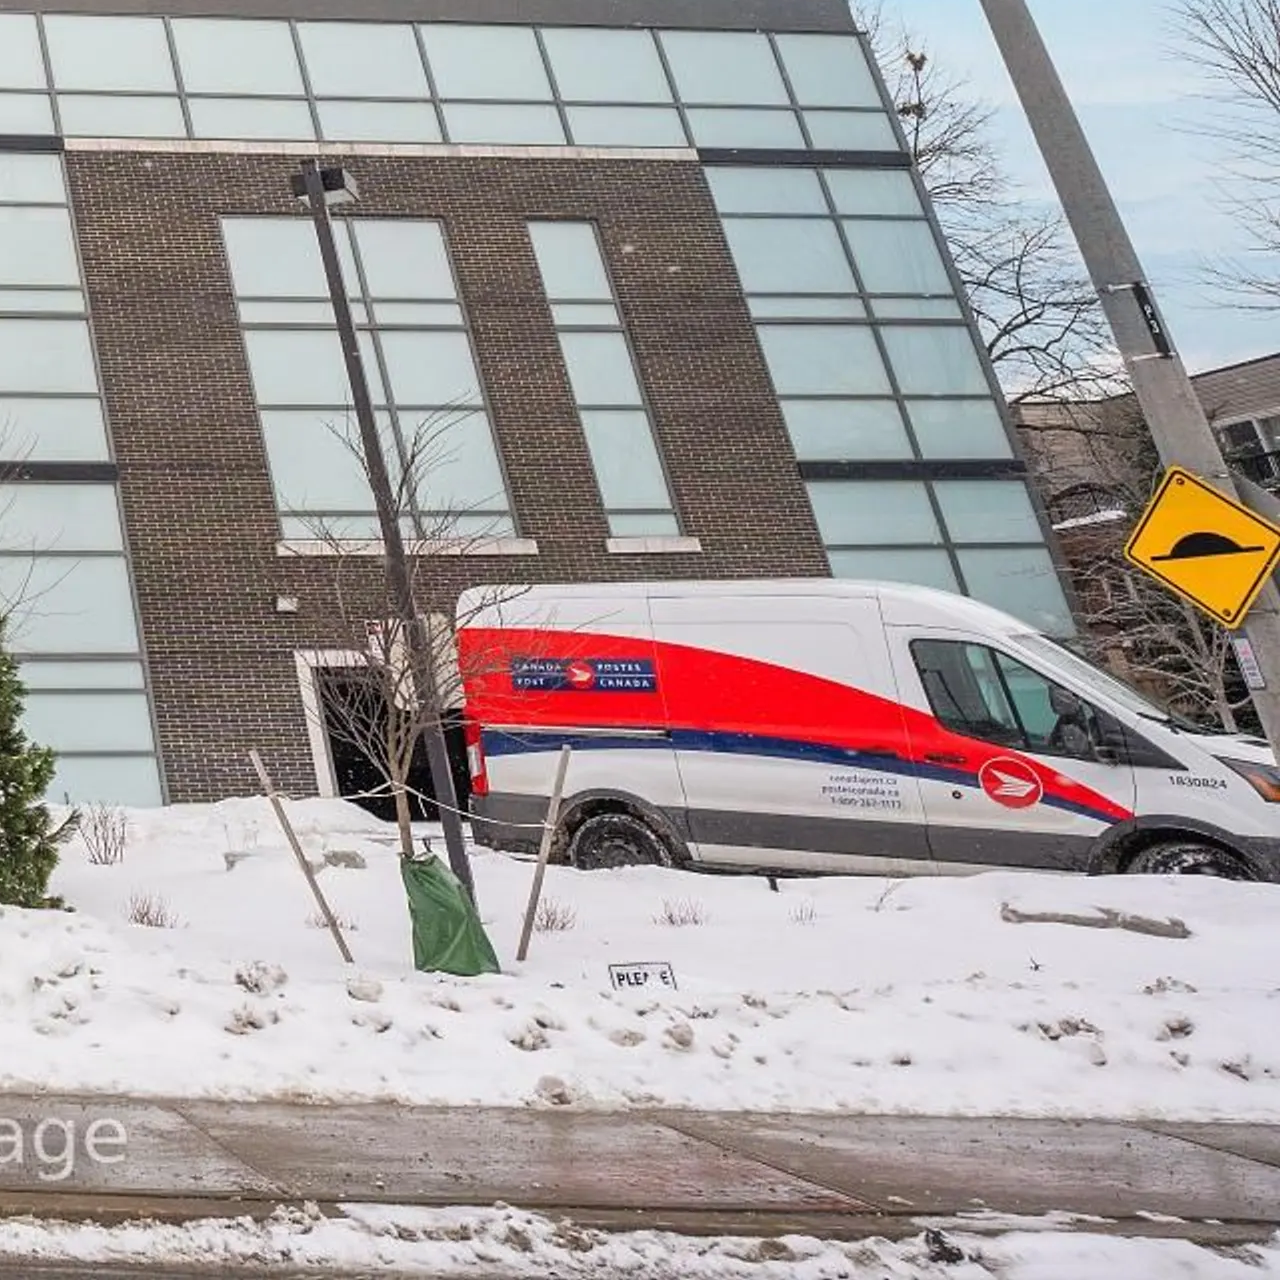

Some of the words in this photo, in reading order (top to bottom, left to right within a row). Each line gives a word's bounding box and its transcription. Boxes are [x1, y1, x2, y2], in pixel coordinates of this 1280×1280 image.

[597, 662, 642, 672] POSTES
[517, 678, 544, 686] POST
[600, 678, 650, 688] CANADA
[616, 970, 671, 987] PLEE
